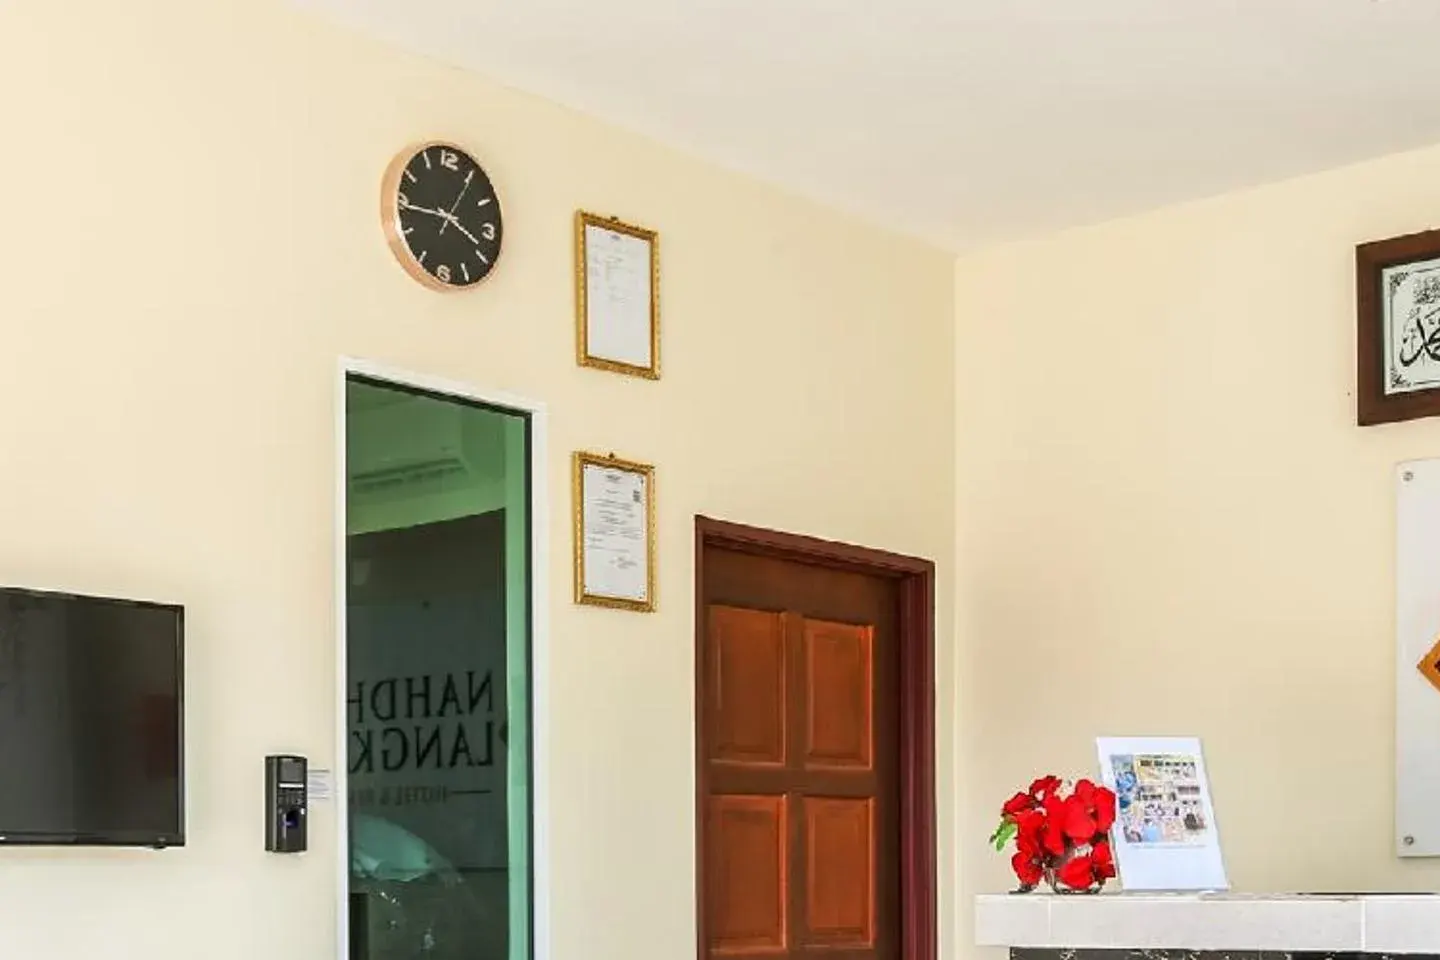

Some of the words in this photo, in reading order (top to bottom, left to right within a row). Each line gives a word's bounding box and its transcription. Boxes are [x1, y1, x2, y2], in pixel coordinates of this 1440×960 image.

[440, 150, 459, 171] 12
[481, 222, 495, 241] 3
[436, 264, 451, 283] 6
